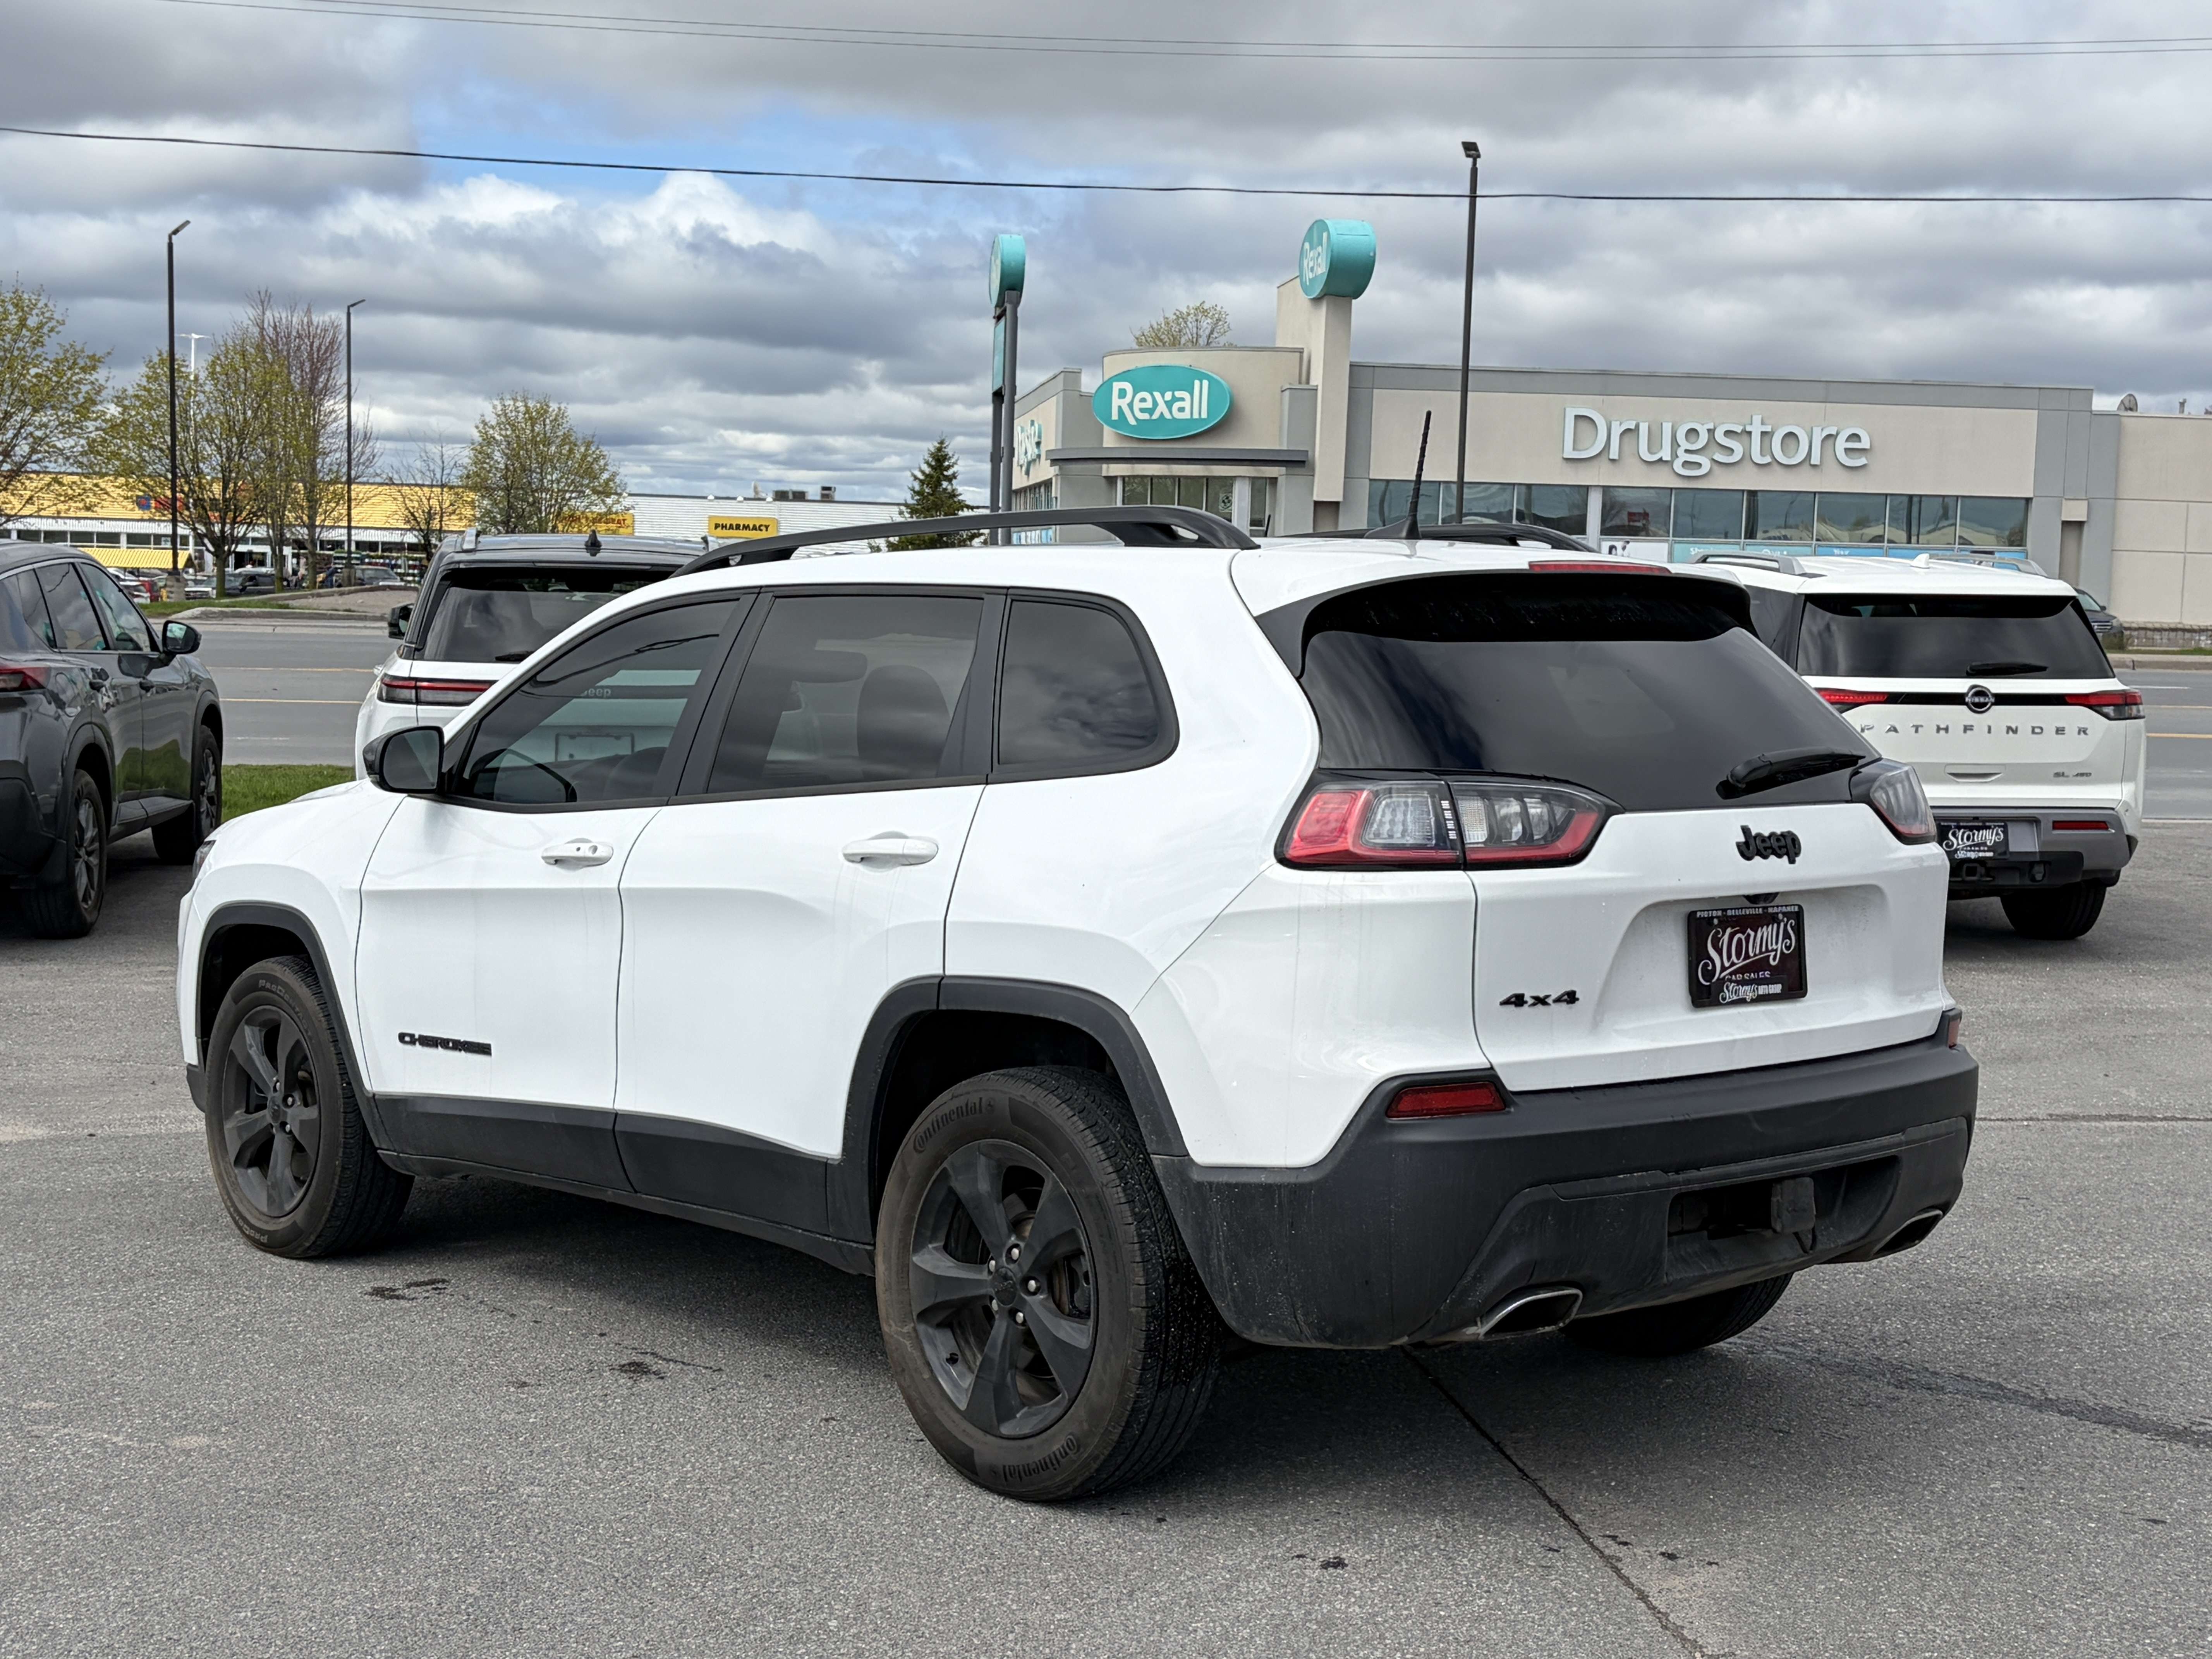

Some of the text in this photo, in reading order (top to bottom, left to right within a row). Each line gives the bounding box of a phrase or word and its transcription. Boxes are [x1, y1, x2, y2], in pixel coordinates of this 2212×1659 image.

[1303, 231, 1328, 286] Rexall
[1111, 380, 1209, 426] Rexall
[1563, 407, 1870, 476] Drugstore
[714, 523, 770, 532] PHARMACY
[1860, 723, 2089, 736] PATHFINDER
[1735, 825, 1802, 864] Jeep
[1942, 827, 2004, 851] Stormy's
[1727, 907, 1763, 916] BELLEVILLE
[1698, 917, 1796, 985] Stormy's
[398, 1032, 492, 1056] CHEROKEE
[913, 1097, 983, 1154] Continental
[1002, 1433, 1081, 1483] Continental
